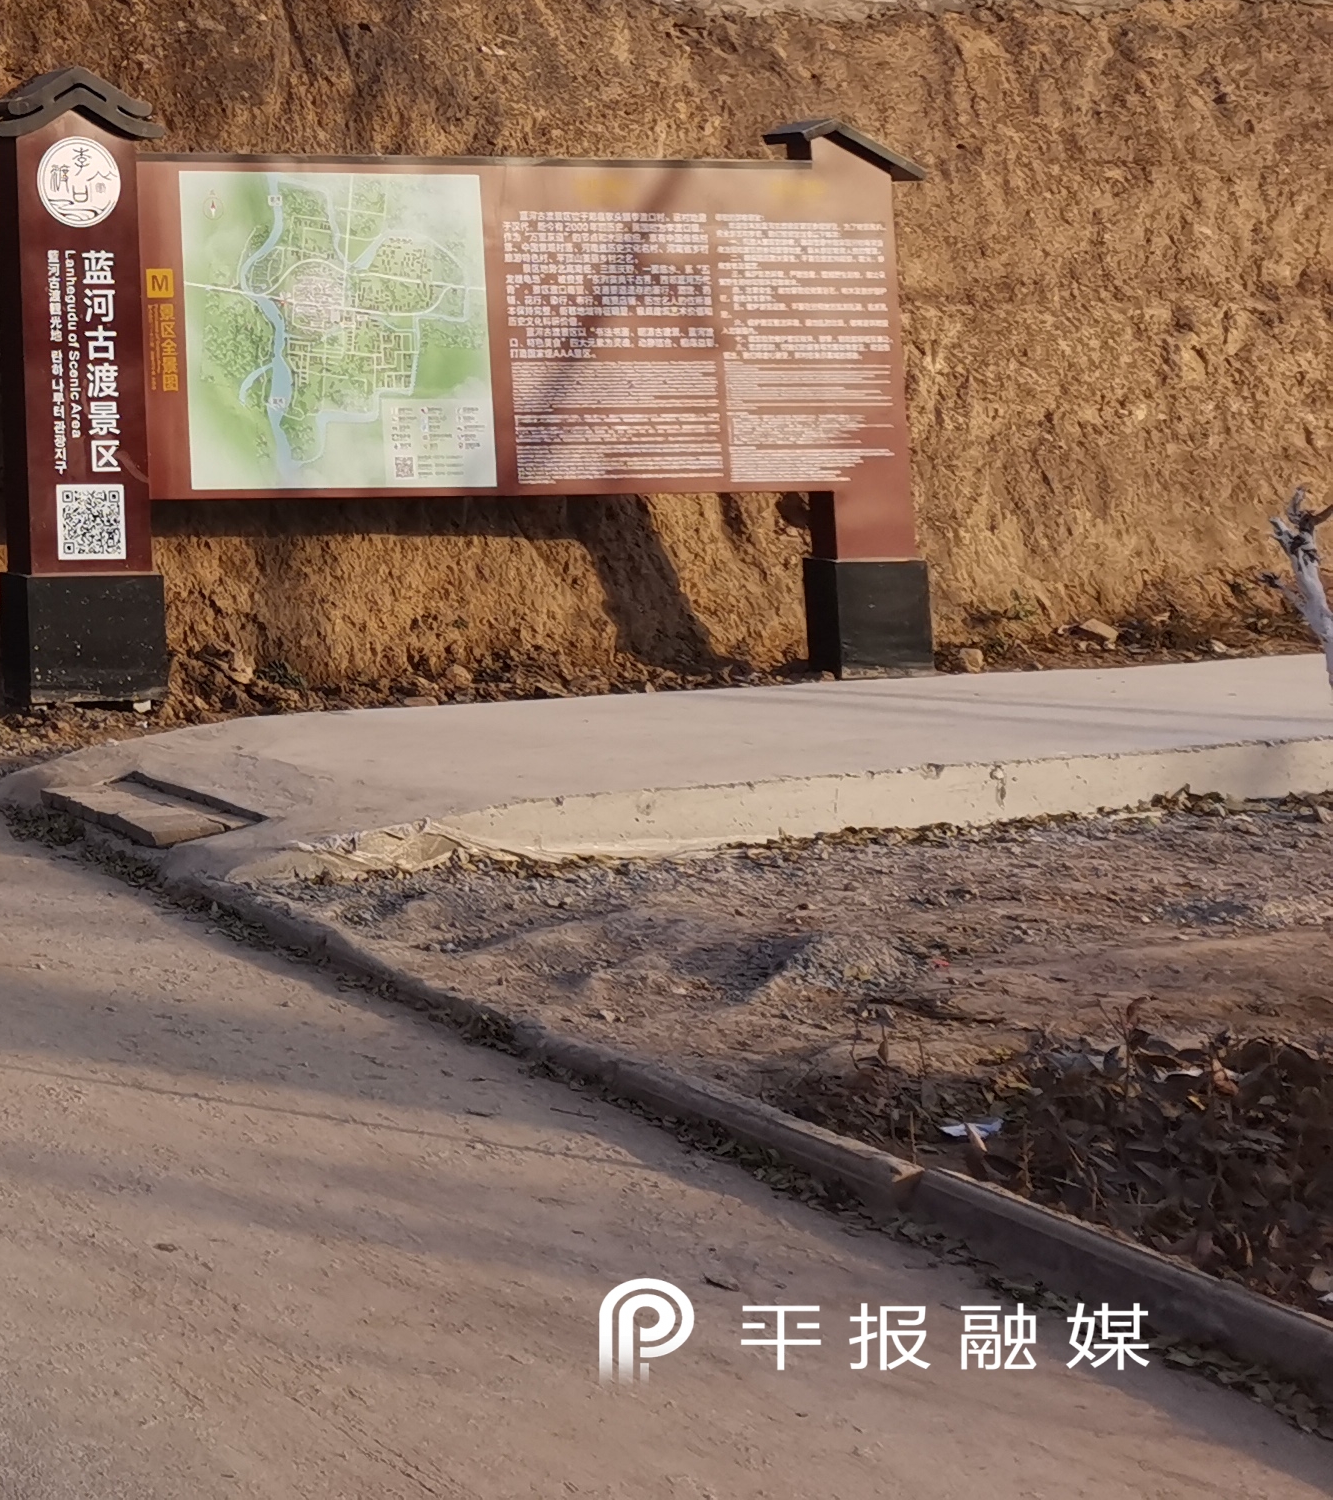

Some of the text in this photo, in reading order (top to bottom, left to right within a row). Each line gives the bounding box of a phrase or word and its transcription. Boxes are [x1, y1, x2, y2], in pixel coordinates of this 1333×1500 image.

[67, 333, 80, 349] of
[81, 249, 121, 473] 蓝河古渡景区
[159, 303, 179, 392] 景区全景图
[68, 350, 81, 400] Scenic
[71, 402, 82, 438] Area
